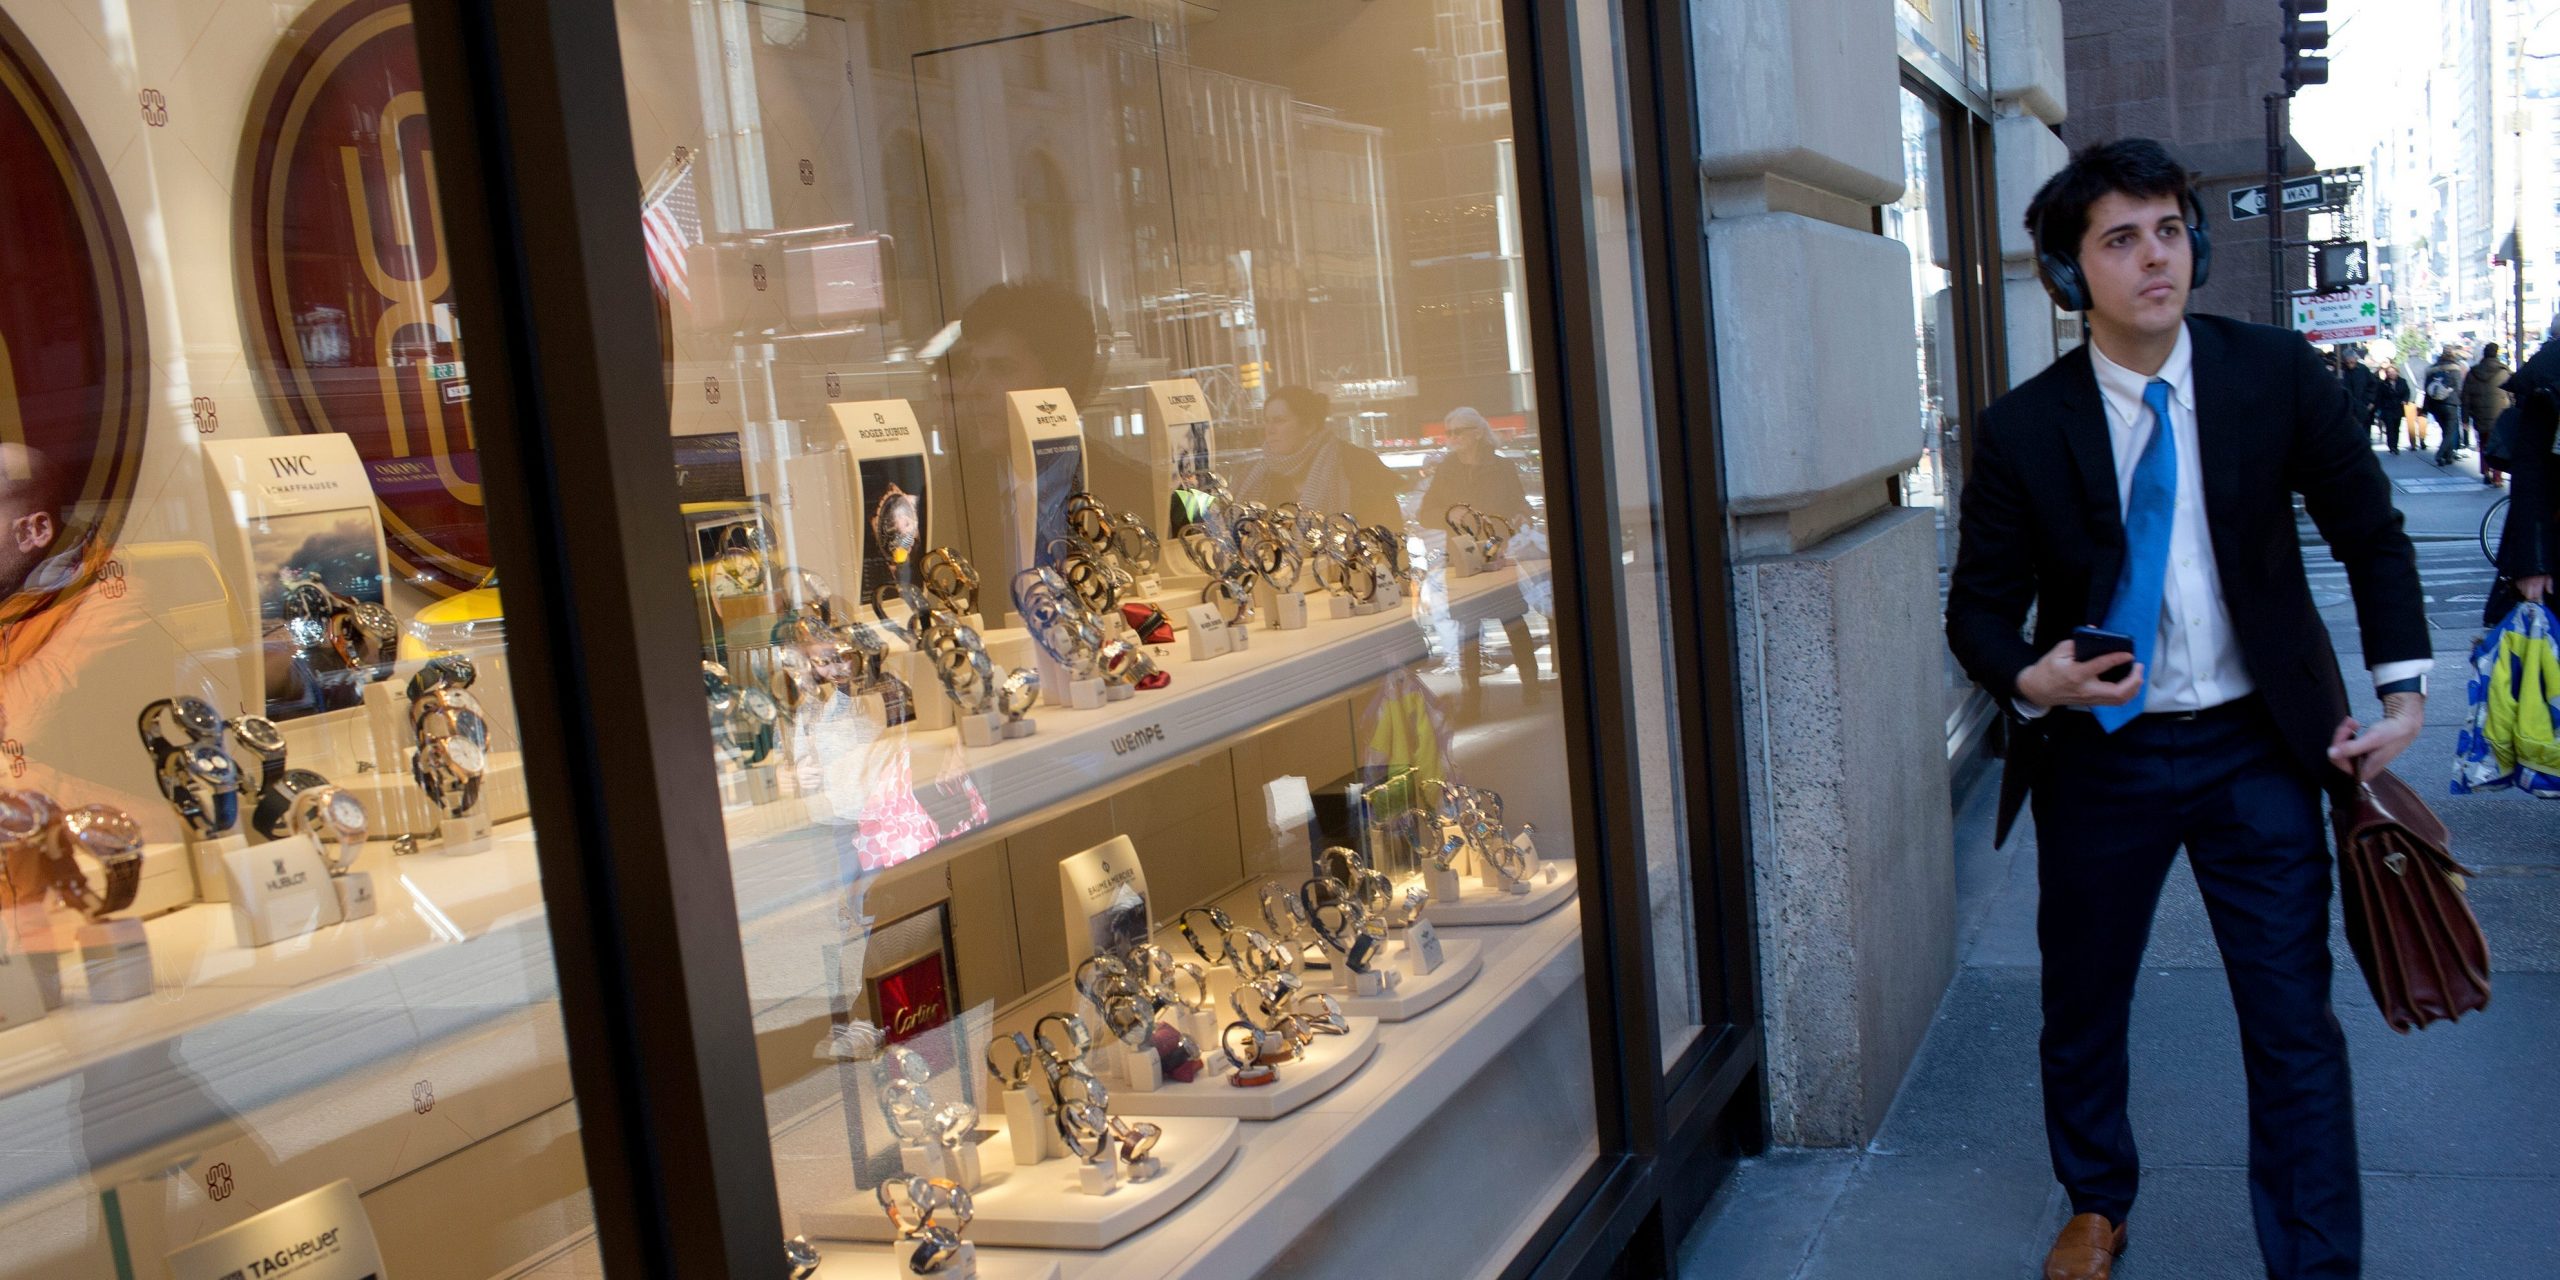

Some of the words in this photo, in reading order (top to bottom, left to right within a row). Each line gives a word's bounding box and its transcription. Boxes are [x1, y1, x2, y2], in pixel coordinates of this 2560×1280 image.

[2286, 185, 2314, 201] WAY
[1036, 414, 1067, 425] BREITLING
[858, 428, 883, 439] ROGER
[268, 454, 317, 478] IWC
[1111, 723, 1165, 756] WEMPE
[265, 871, 307, 892] HUBLOT
[1087, 880, 1108, 896] BAUME
[894, 1003, 939, 1035] Cartier
